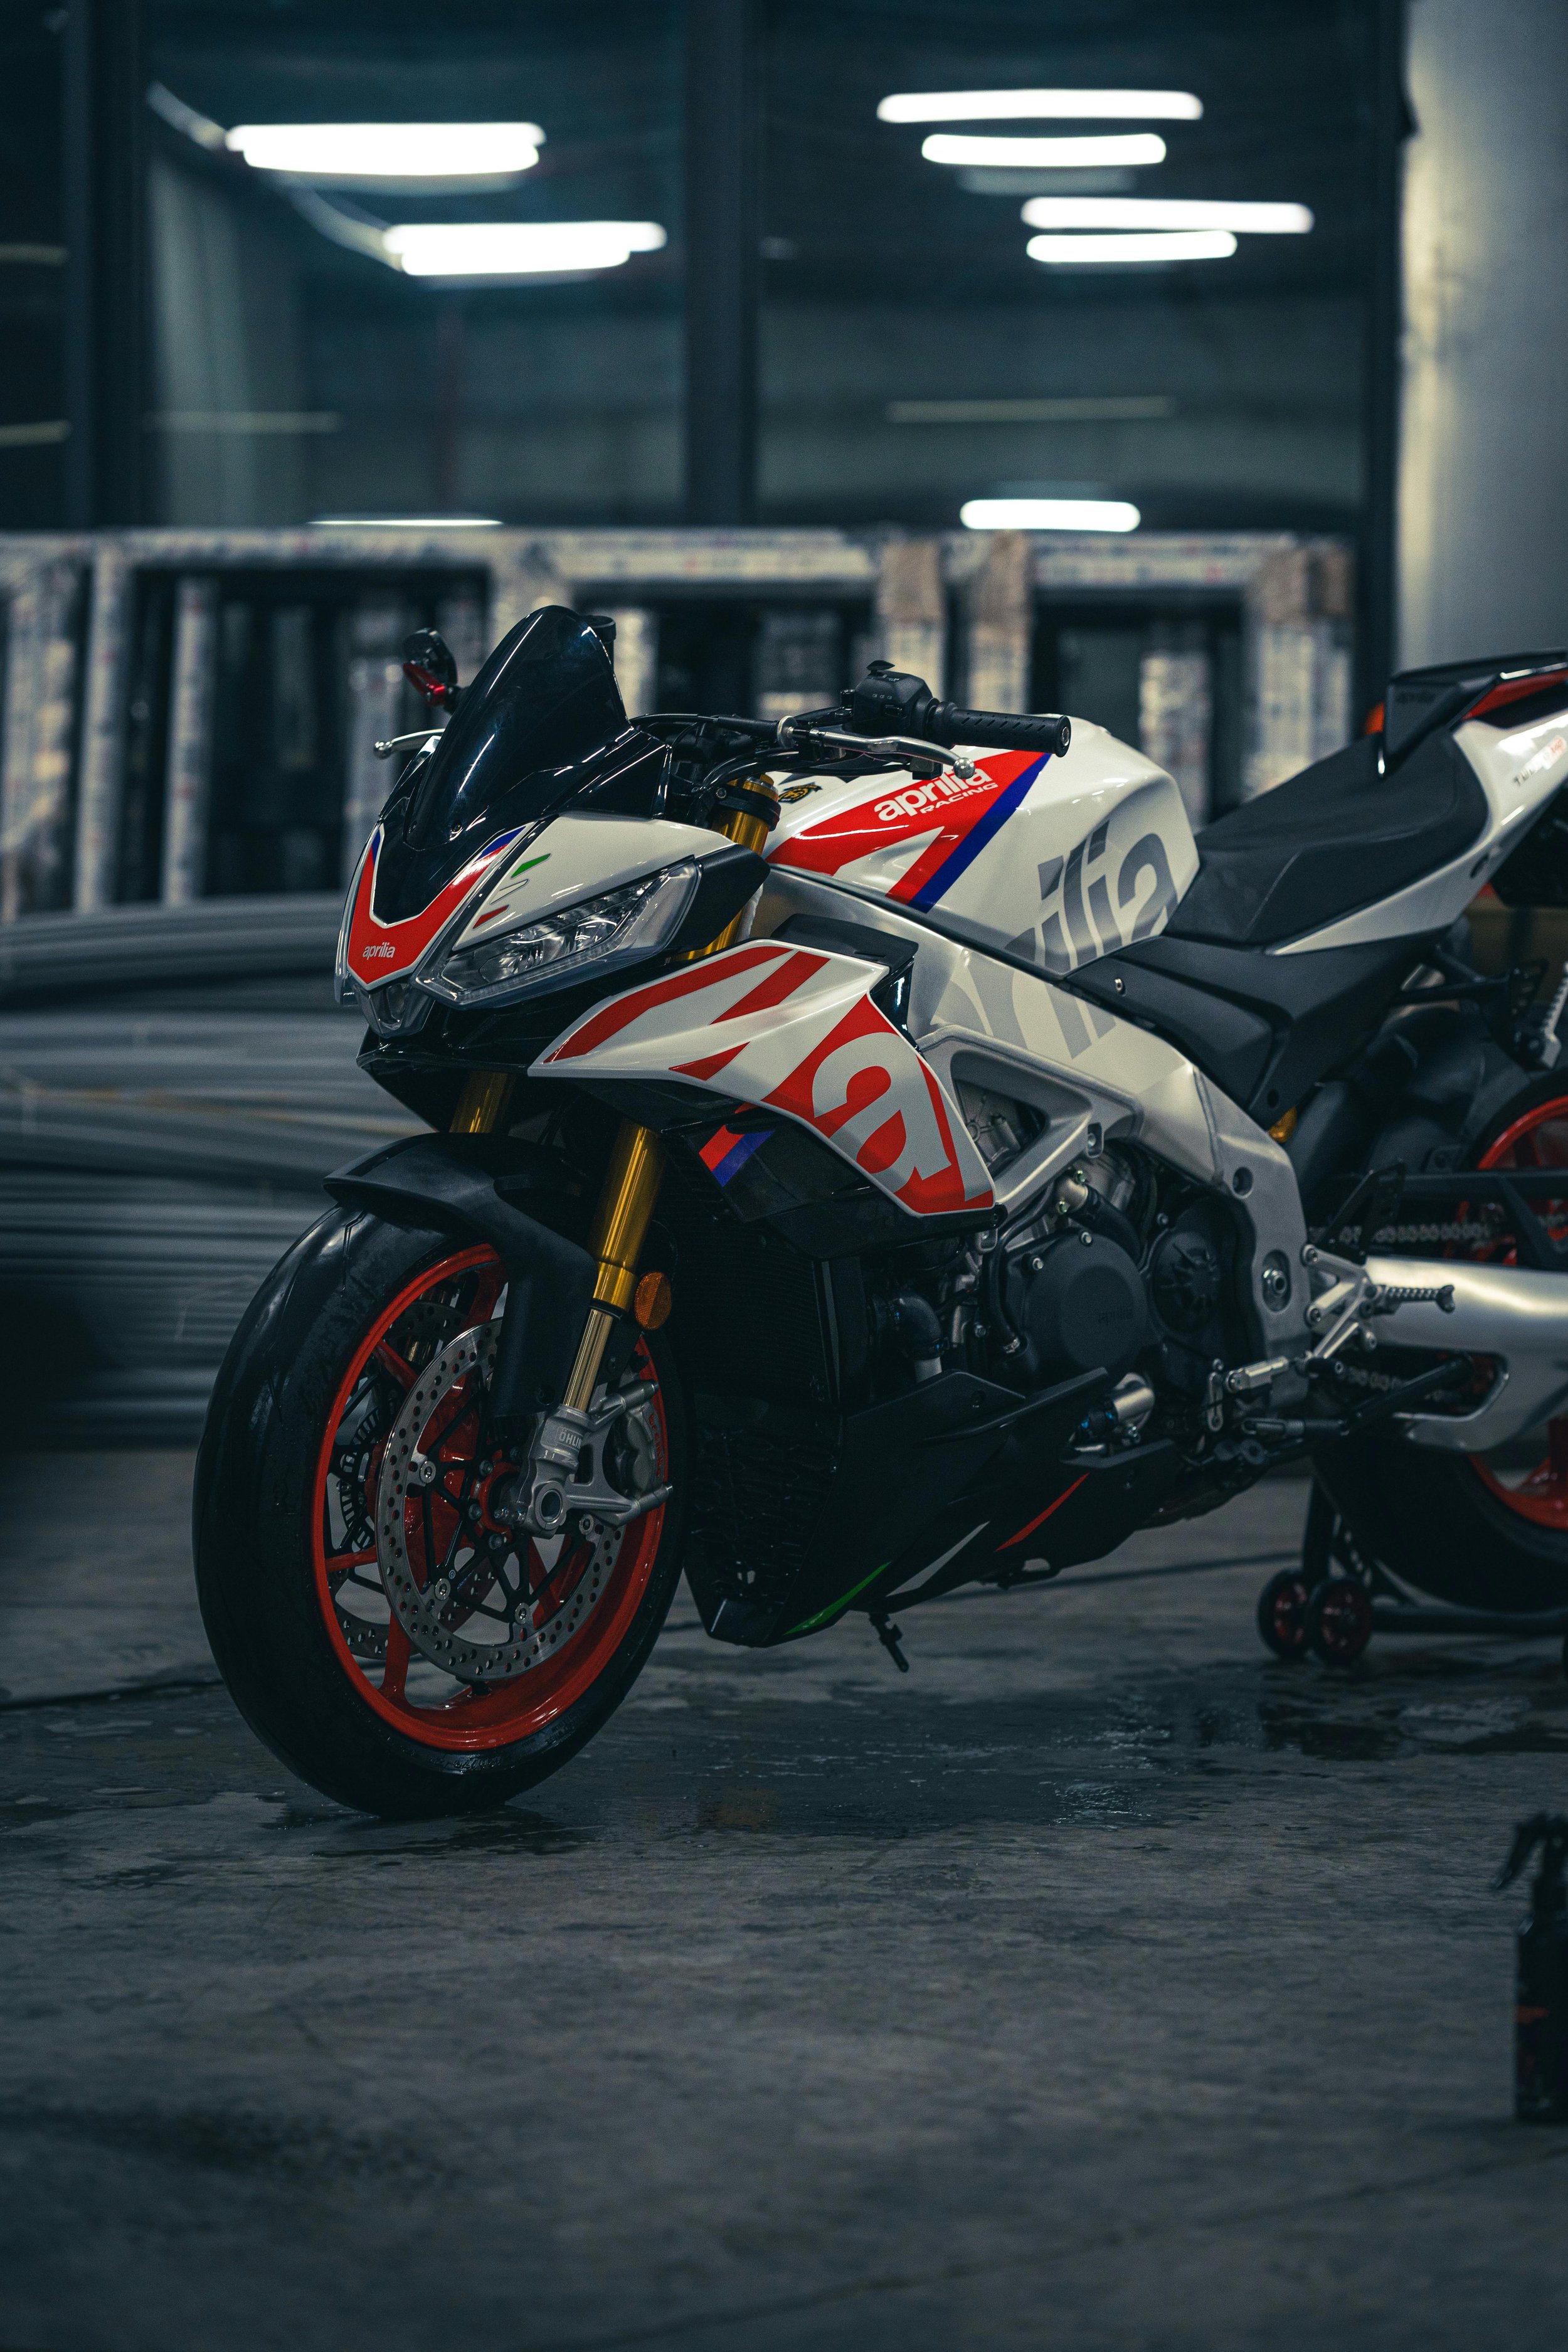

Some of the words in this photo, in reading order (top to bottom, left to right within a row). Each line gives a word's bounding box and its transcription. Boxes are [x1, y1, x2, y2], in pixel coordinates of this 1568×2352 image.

[874, 766, 993, 821] aprilia
[919, 783, 999, 813] RACING
[362, 941, 396, 960] aprilia
